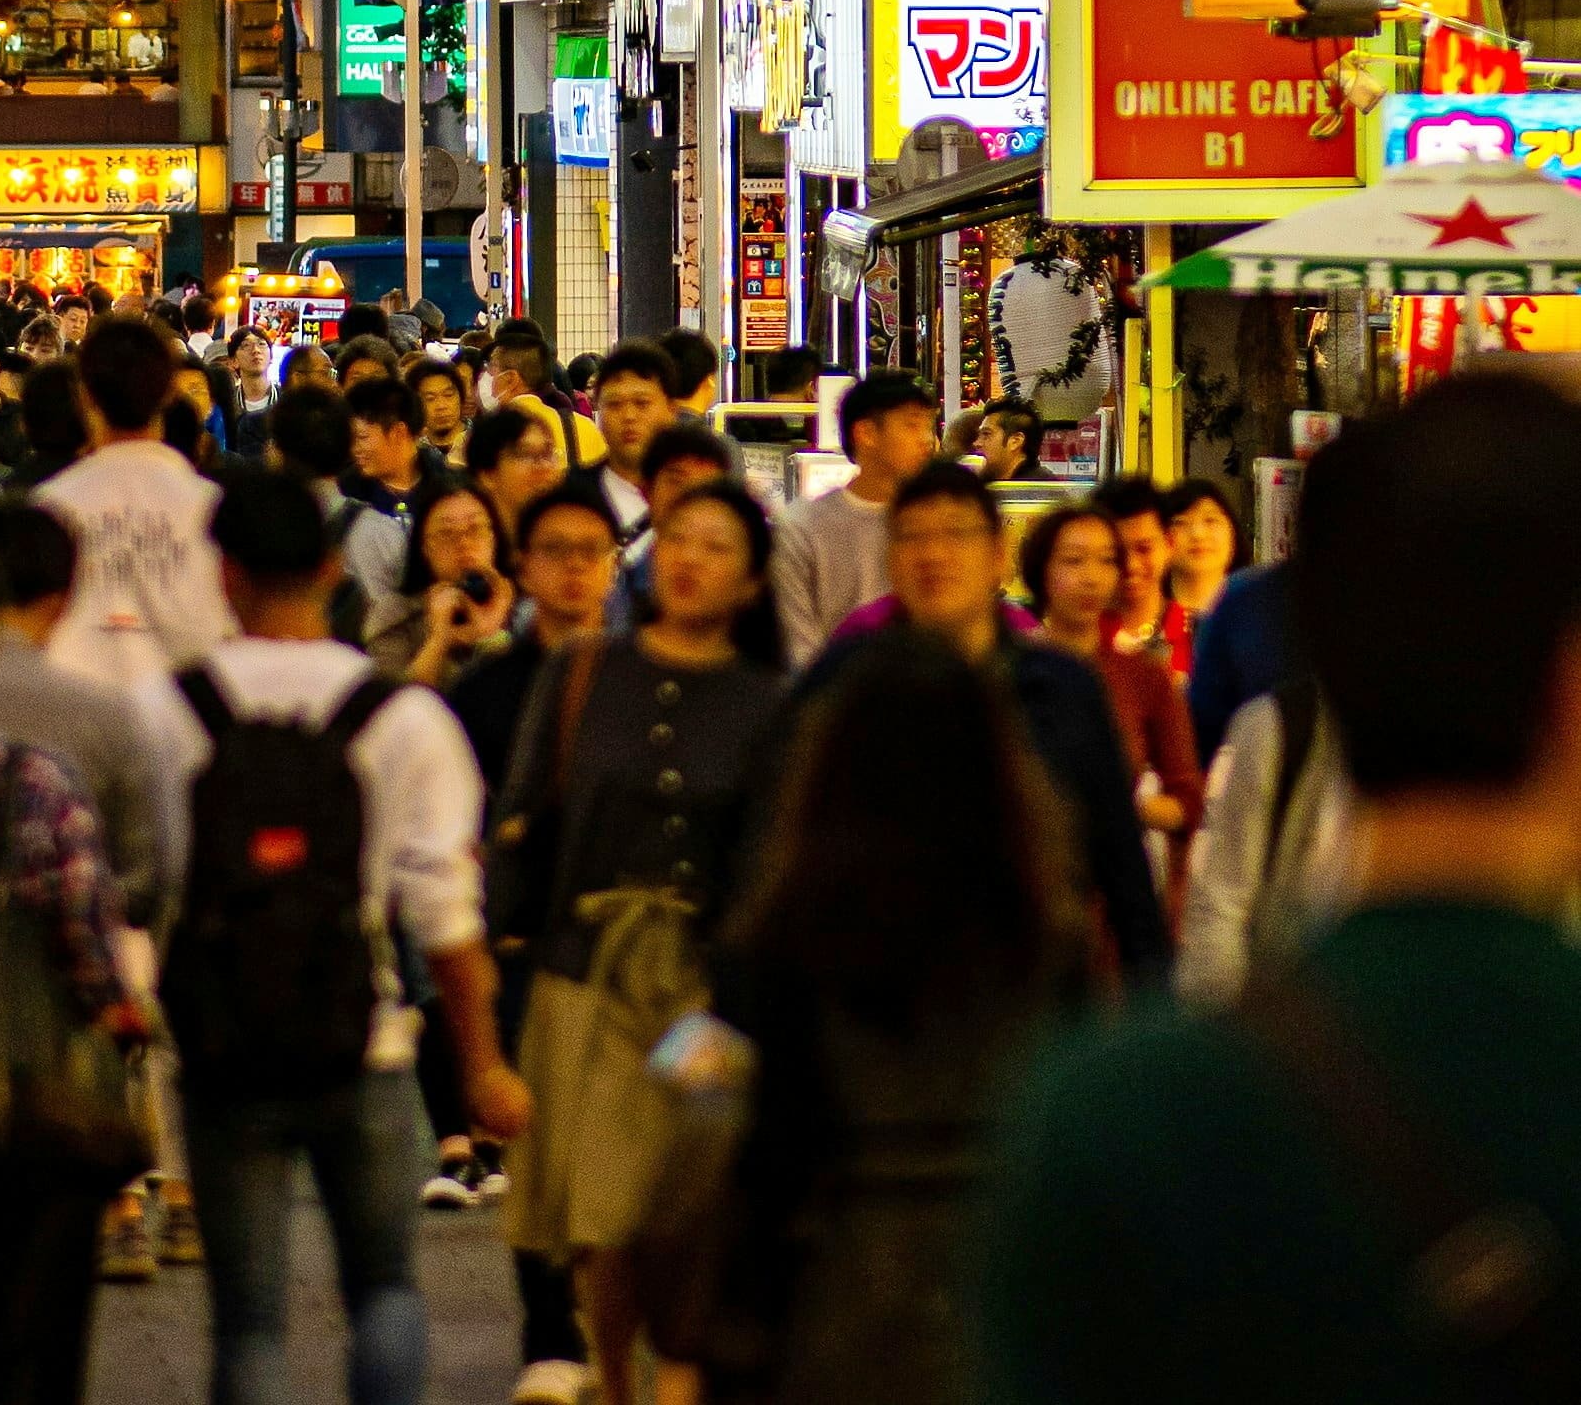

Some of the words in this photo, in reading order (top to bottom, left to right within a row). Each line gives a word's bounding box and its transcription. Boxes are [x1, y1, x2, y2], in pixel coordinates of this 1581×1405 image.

[1116, 81, 1233, 115] ONLINE
[1248, 79, 1332, 114] CAFE
[1204, 132, 1245, 167] B1
